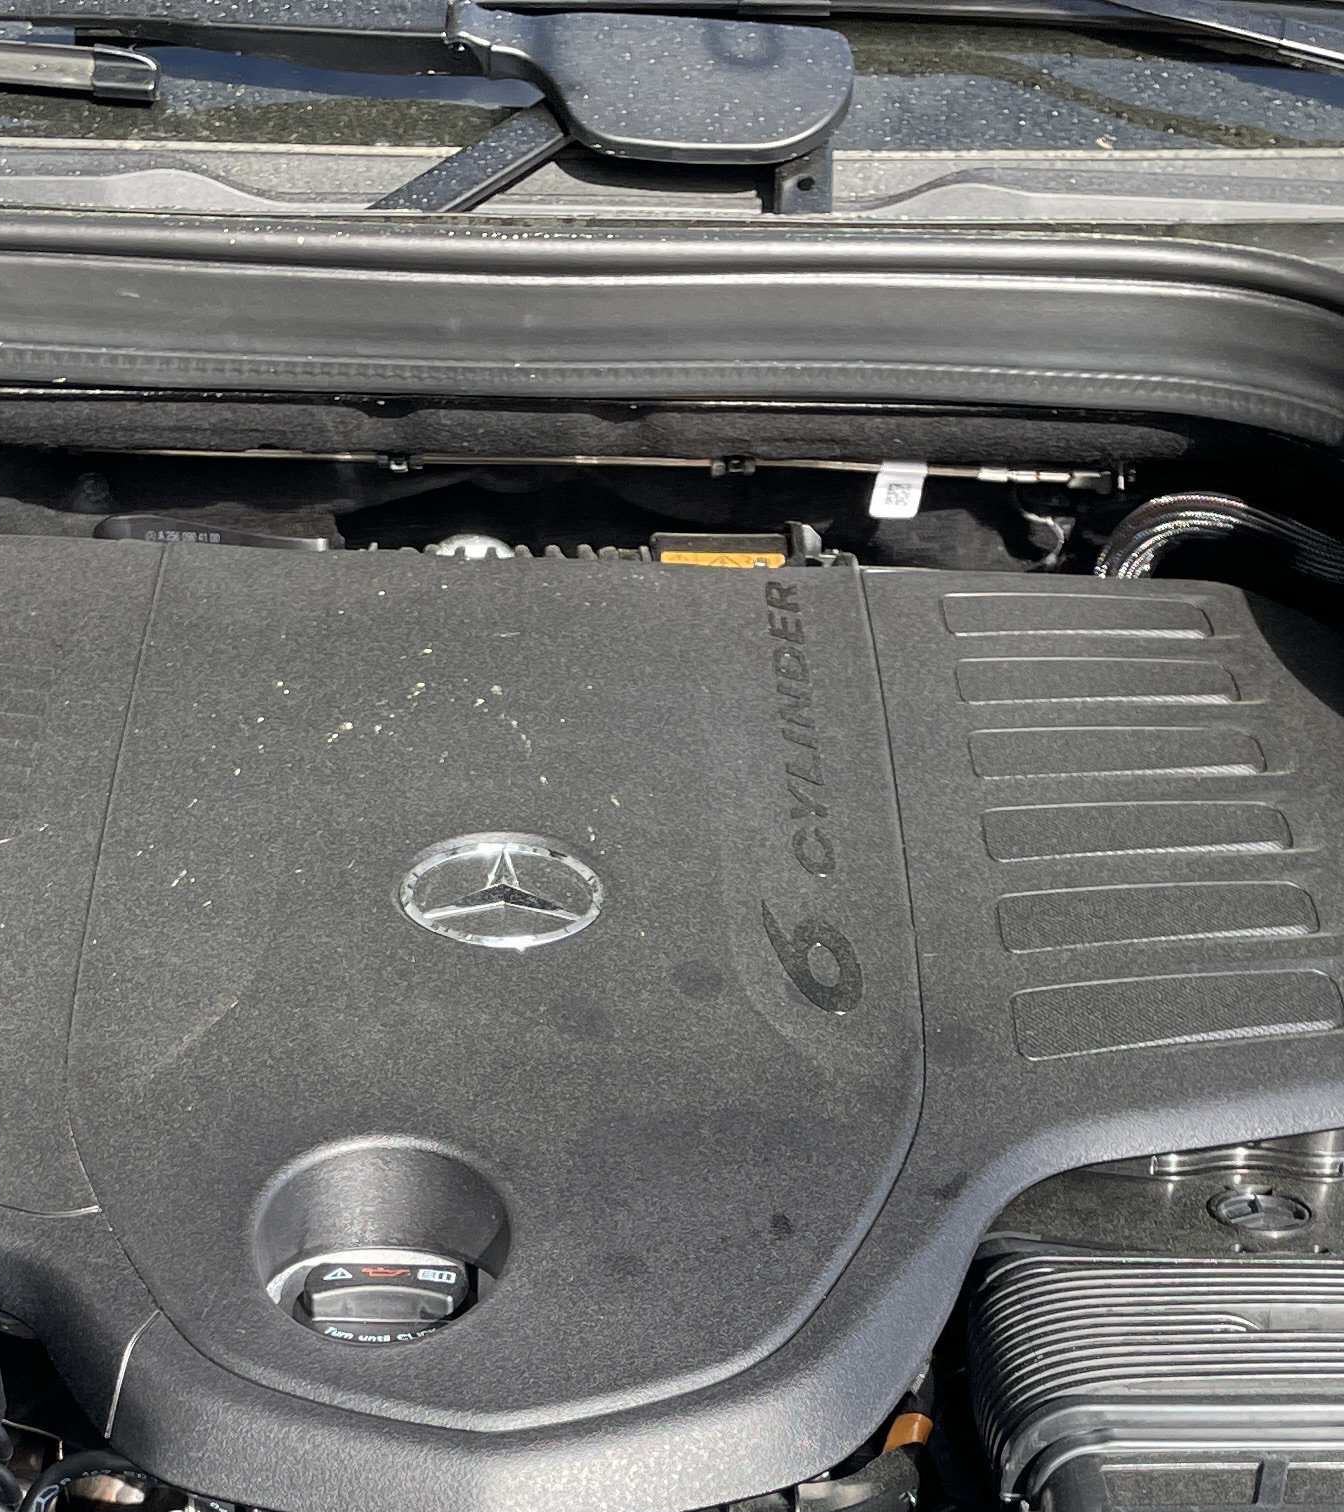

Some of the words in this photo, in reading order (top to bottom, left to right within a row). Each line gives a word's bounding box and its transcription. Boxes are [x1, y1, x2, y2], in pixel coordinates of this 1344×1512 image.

[764, 580, 837, 877] CYLINDER
[761, 899, 864, 1014] 6
[324, 1325, 354, 1340] Turn
[358, 1333, 391, 1343] until
